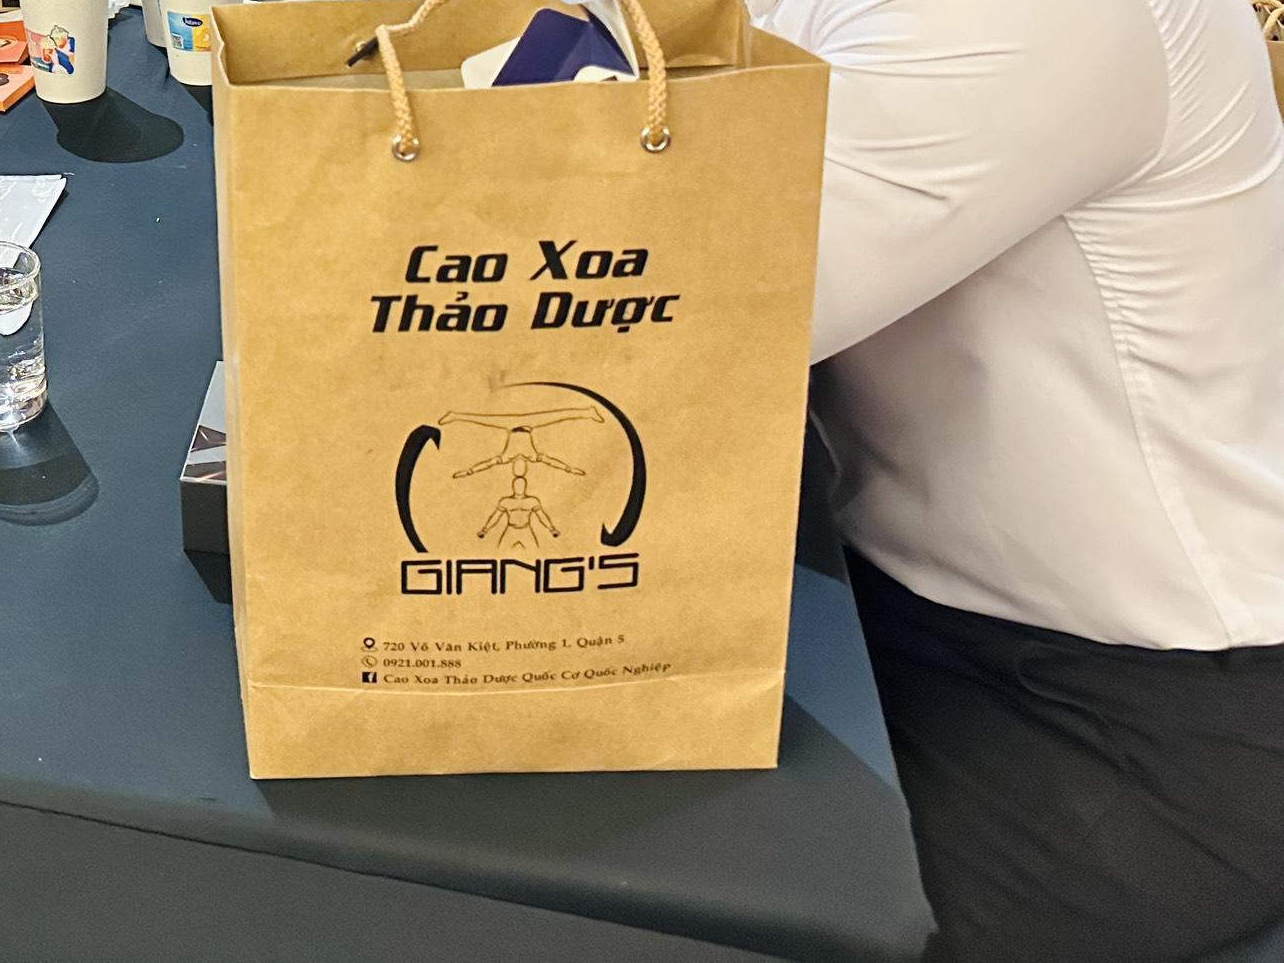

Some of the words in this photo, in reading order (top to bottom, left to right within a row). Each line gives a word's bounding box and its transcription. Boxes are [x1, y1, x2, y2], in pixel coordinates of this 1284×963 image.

[405, 245, 508, 284] Cao
[529, 239, 649, 281] Xoa
[370, 291, 508, 333] Thảo
[530, 291, 681, 333] Dược
[400, 552, 640, 595] GIANG'S
[383, 641, 405, 651] 720
[617, 634, 625, 645] 5
[383, 658, 462, 669] 0921.001.888
[383, 674, 409, 684] Cao
[414, 674, 439, 685] Xoa
